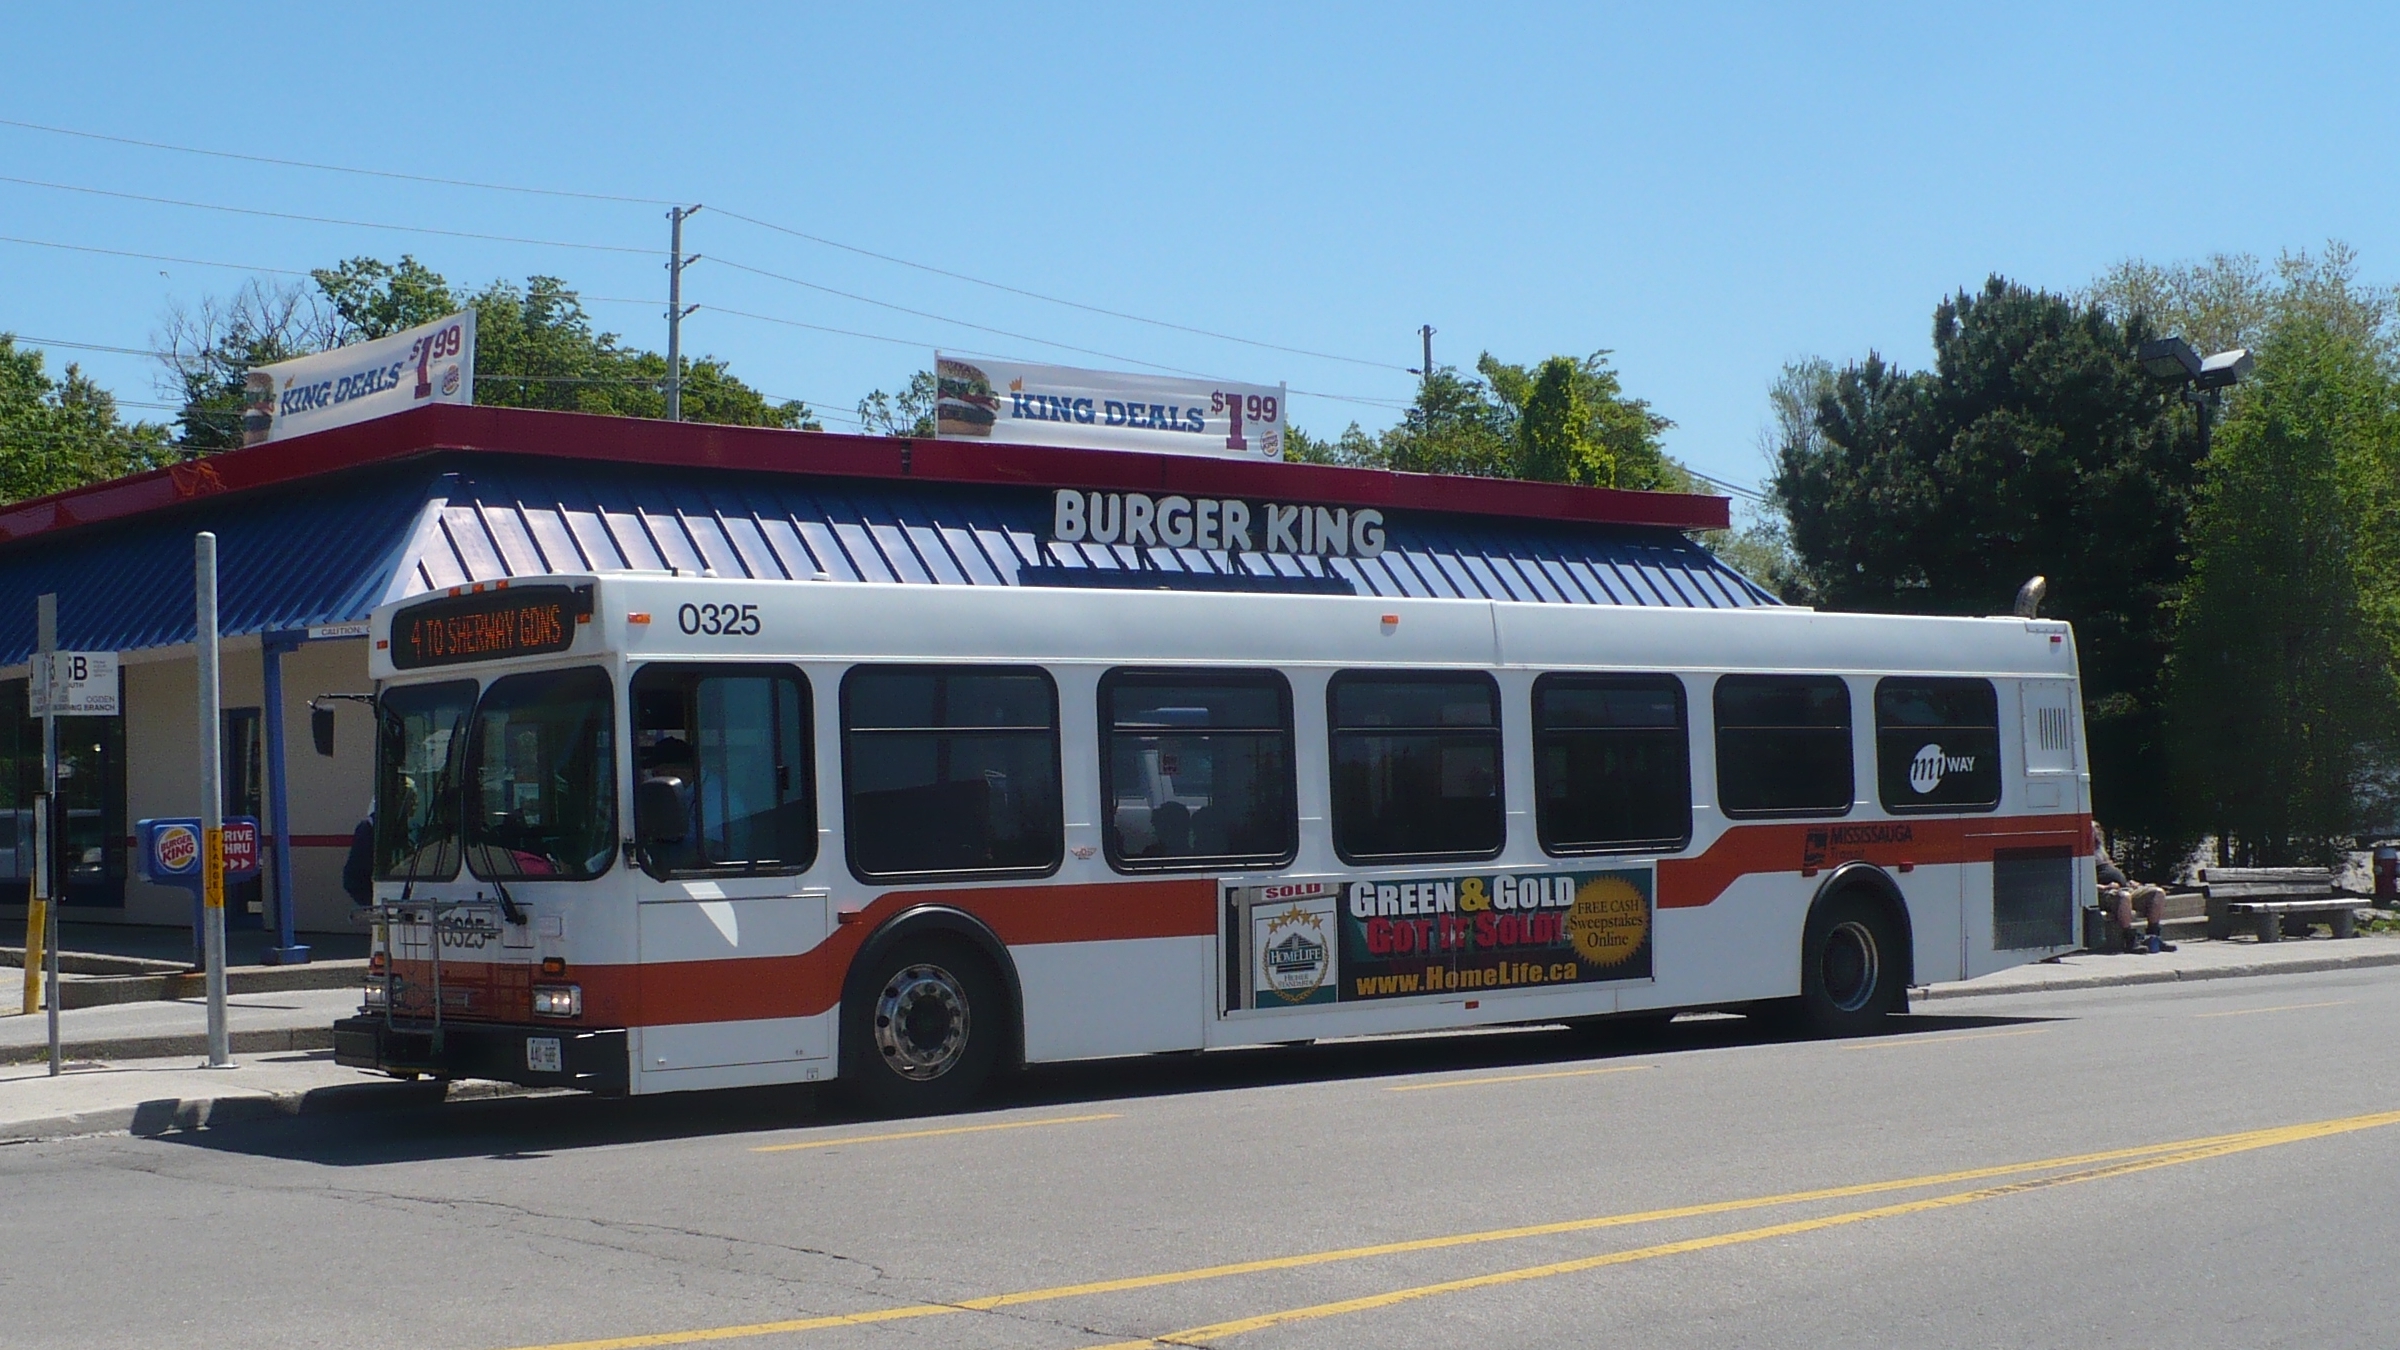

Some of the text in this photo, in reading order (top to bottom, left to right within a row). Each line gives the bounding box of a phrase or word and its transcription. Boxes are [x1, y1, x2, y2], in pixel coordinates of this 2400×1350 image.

[281, 380, 332, 417] KING
[334, 362, 402, 403] DEALS
[1010, 393, 1095, 425] KING
[1104, 400, 1205, 433] DEALS
[1053, 489, 1386, 557] BURGER KING
[678, 603, 761, 636] 0325
[410, 603, 563, 660] 4 TO SHERWAY GDNS
[84, 703, 115, 711] BRANCH
[86, 695, 115, 703] OGDEN
[1947, 756, 1976, 772] WAY
[161, 834, 192, 850] BURGER
[222, 830, 253, 842] RIVE
[1830, 825, 1913, 845] MISSISSAUGA
[162, 842, 194, 863] KING
[222, 842, 251, 854] HRU
[1265, 883, 1321, 899] SOLD
[1350, 874, 1576, 917] GREEN & GOLD
[1578, 899, 1639, 915] FREE CASH
[441, 917, 488, 949] 0325
[1570, 913, 1643, 933] Sweepstakes
[1367, 917, 1432, 954] GOT
[1587, 931, 1629, 948] Online
[1356, 961, 1577, 995] www.HomeLife.ca
